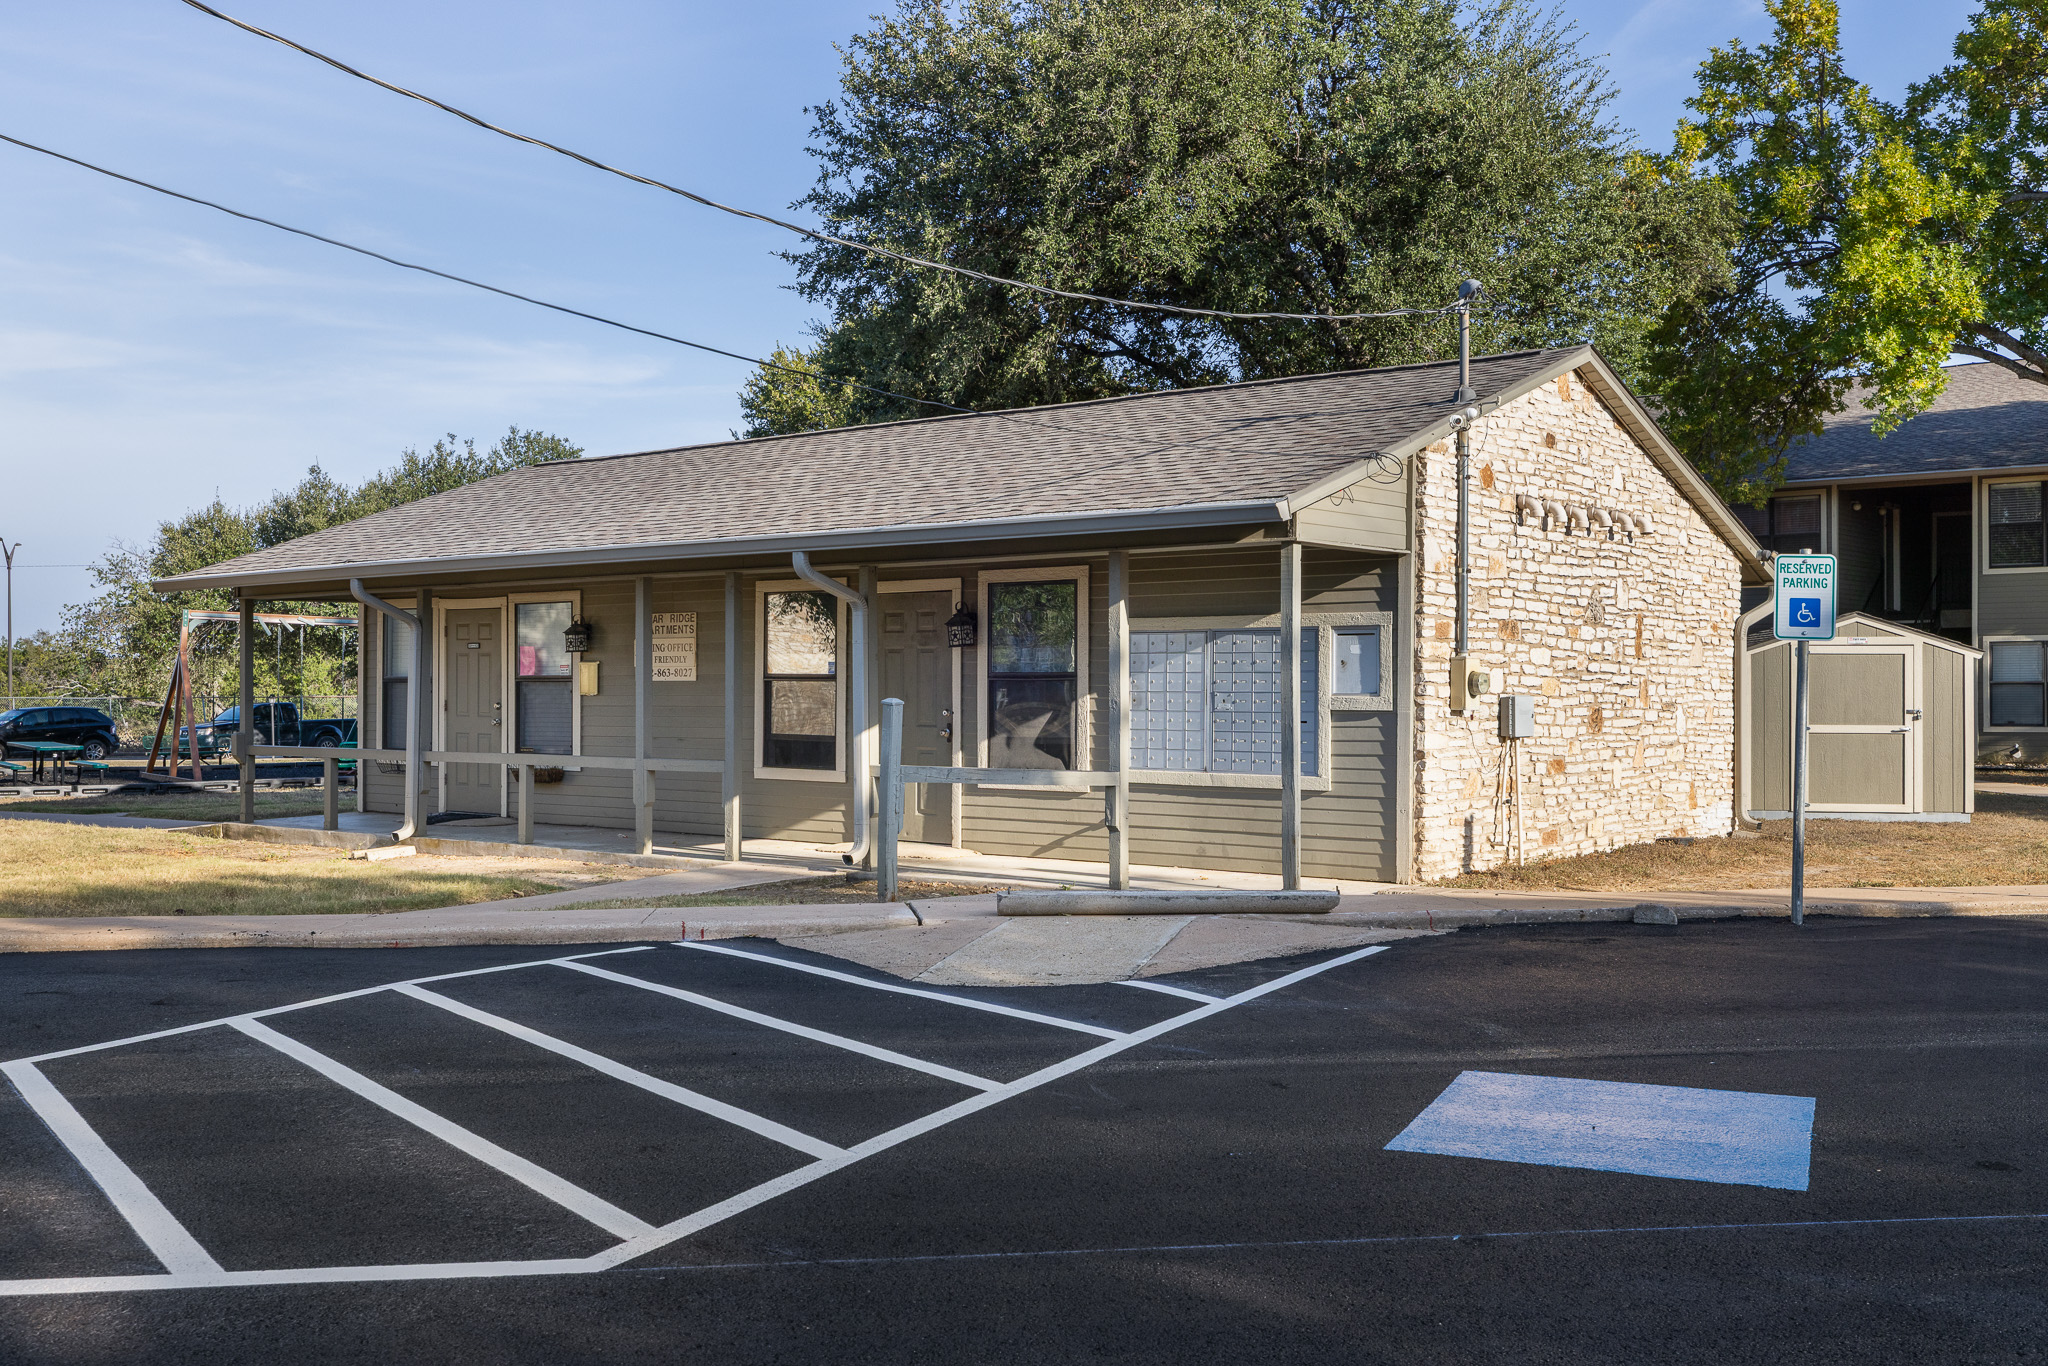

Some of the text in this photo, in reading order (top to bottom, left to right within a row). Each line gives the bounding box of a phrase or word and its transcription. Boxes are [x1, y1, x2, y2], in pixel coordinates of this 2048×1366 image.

[1780, 563, 1832, 574] RESERVED
[1783, 577, 1828, 589] PARKING
[669, 613, 695, 623] RIDGE
[652, 625, 695, 635] RTMENTS
[667, 643, 694, 652] OFFICE
[654, 655, 688, 664] FRIENDLY
[652, 668, 693, 678] -863-8027
